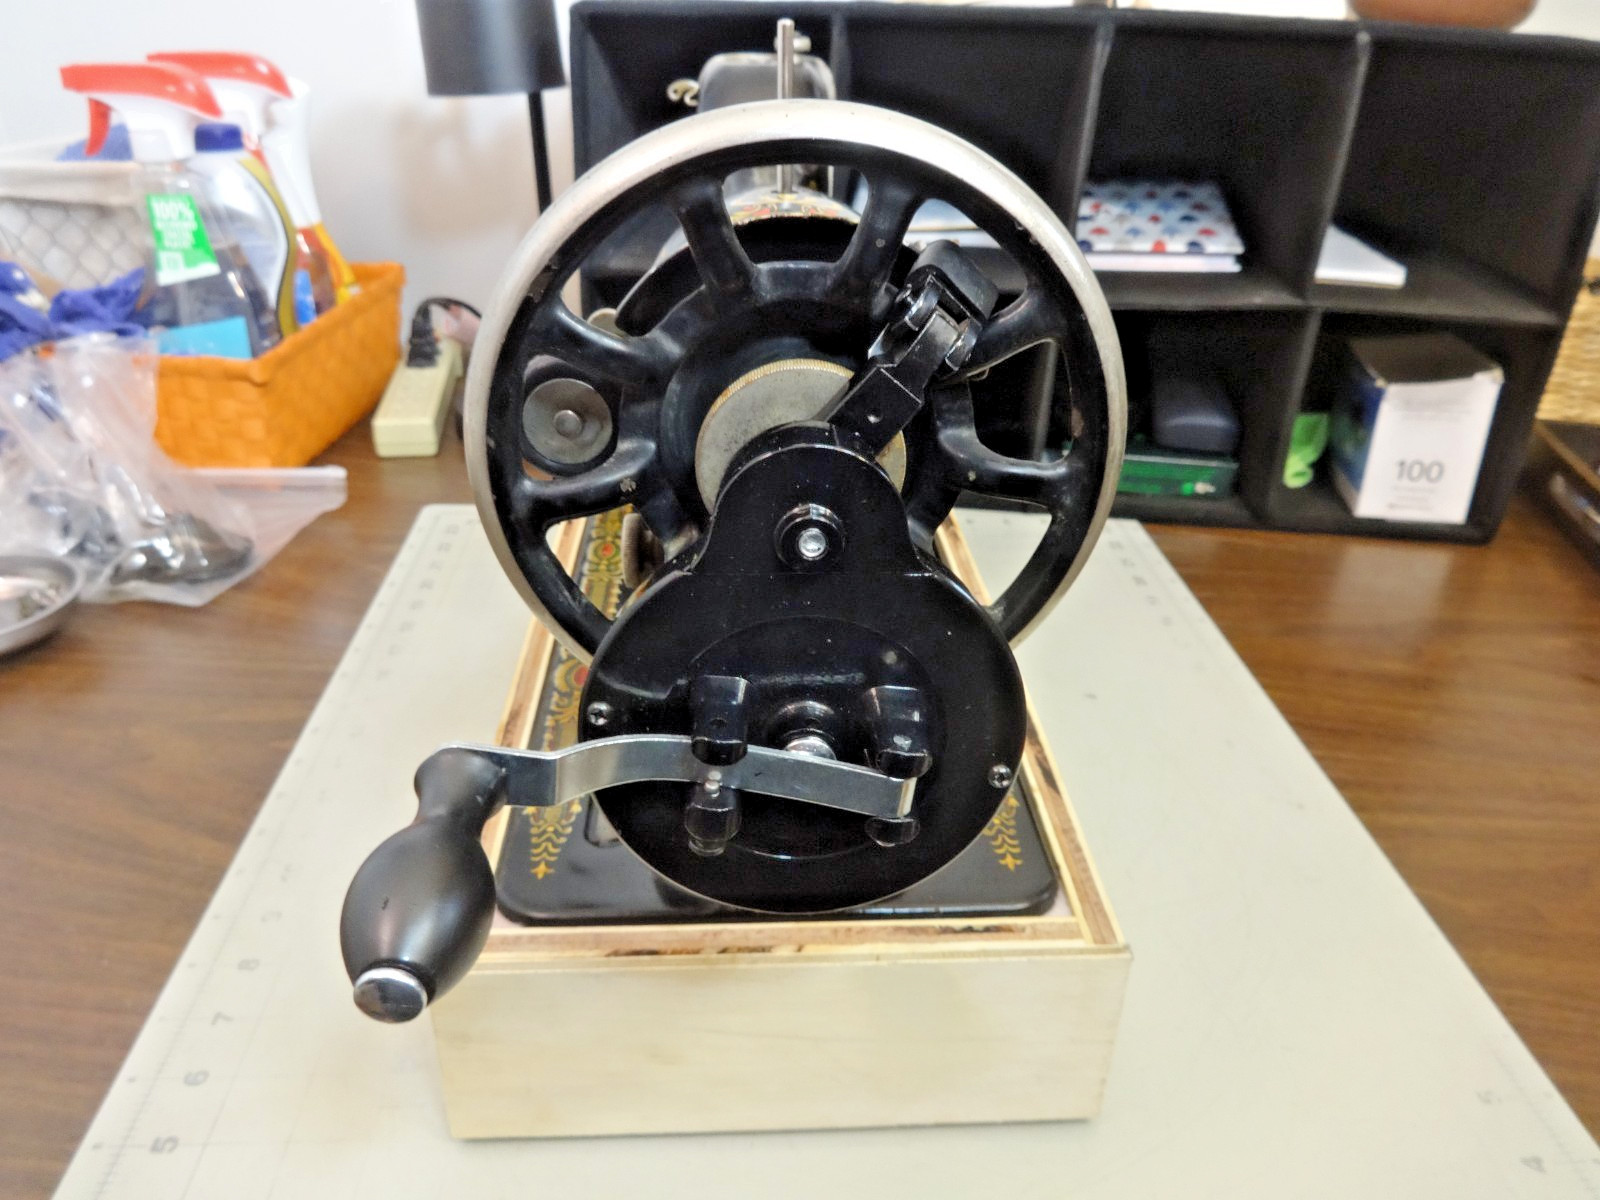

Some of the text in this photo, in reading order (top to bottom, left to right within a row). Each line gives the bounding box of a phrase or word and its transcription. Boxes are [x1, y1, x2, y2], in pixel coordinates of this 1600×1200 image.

[1394, 459, 1445, 484] 100
[211, 1011, 234, 1026] 7
[183, 1069, 210, 1087] 6
[150, 1135, 180, 1154] 5
